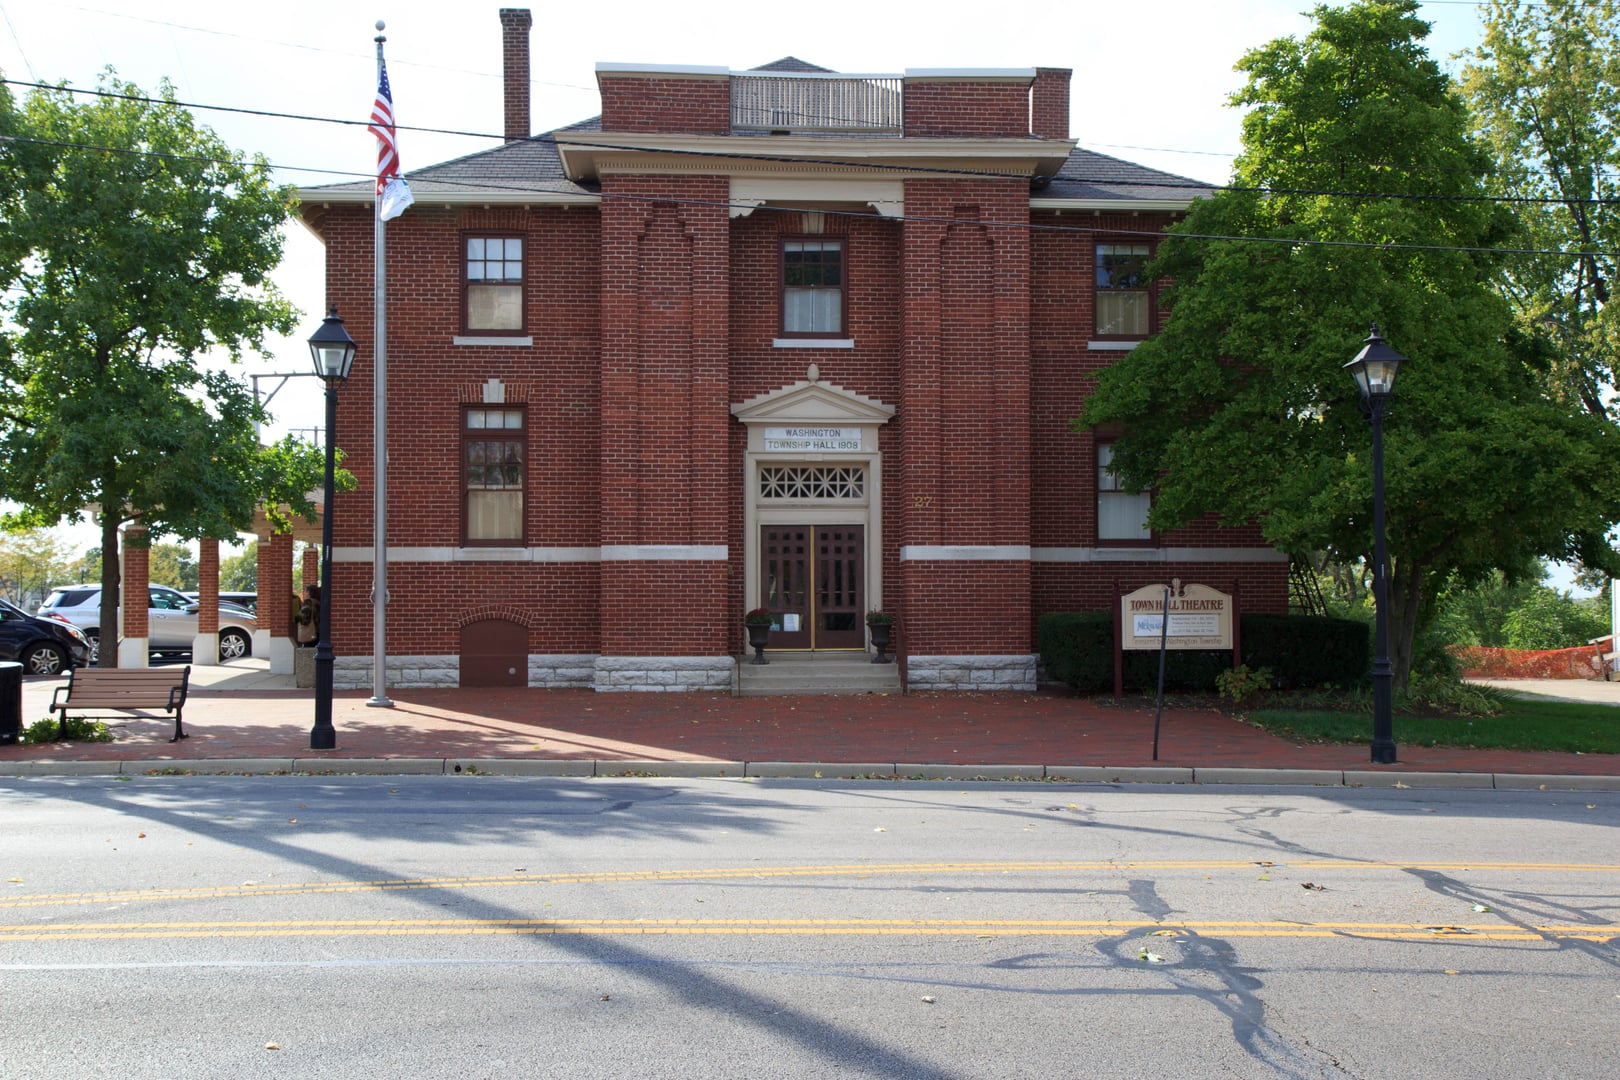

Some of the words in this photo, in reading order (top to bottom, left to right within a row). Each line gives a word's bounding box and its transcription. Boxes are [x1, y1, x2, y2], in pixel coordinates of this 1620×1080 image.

[785, 429, 841, 438] WASHINGTON
[768, 440, 811, 449] TOWNSHIP
[813, 440, 836, 449] HALL
[838, 440, 858, 449] 1908
[915, 496, 933, 508] 27
[1130, 600, 1154, 611] TOWN
[1181, 600, 1223, 610] THEATRE
